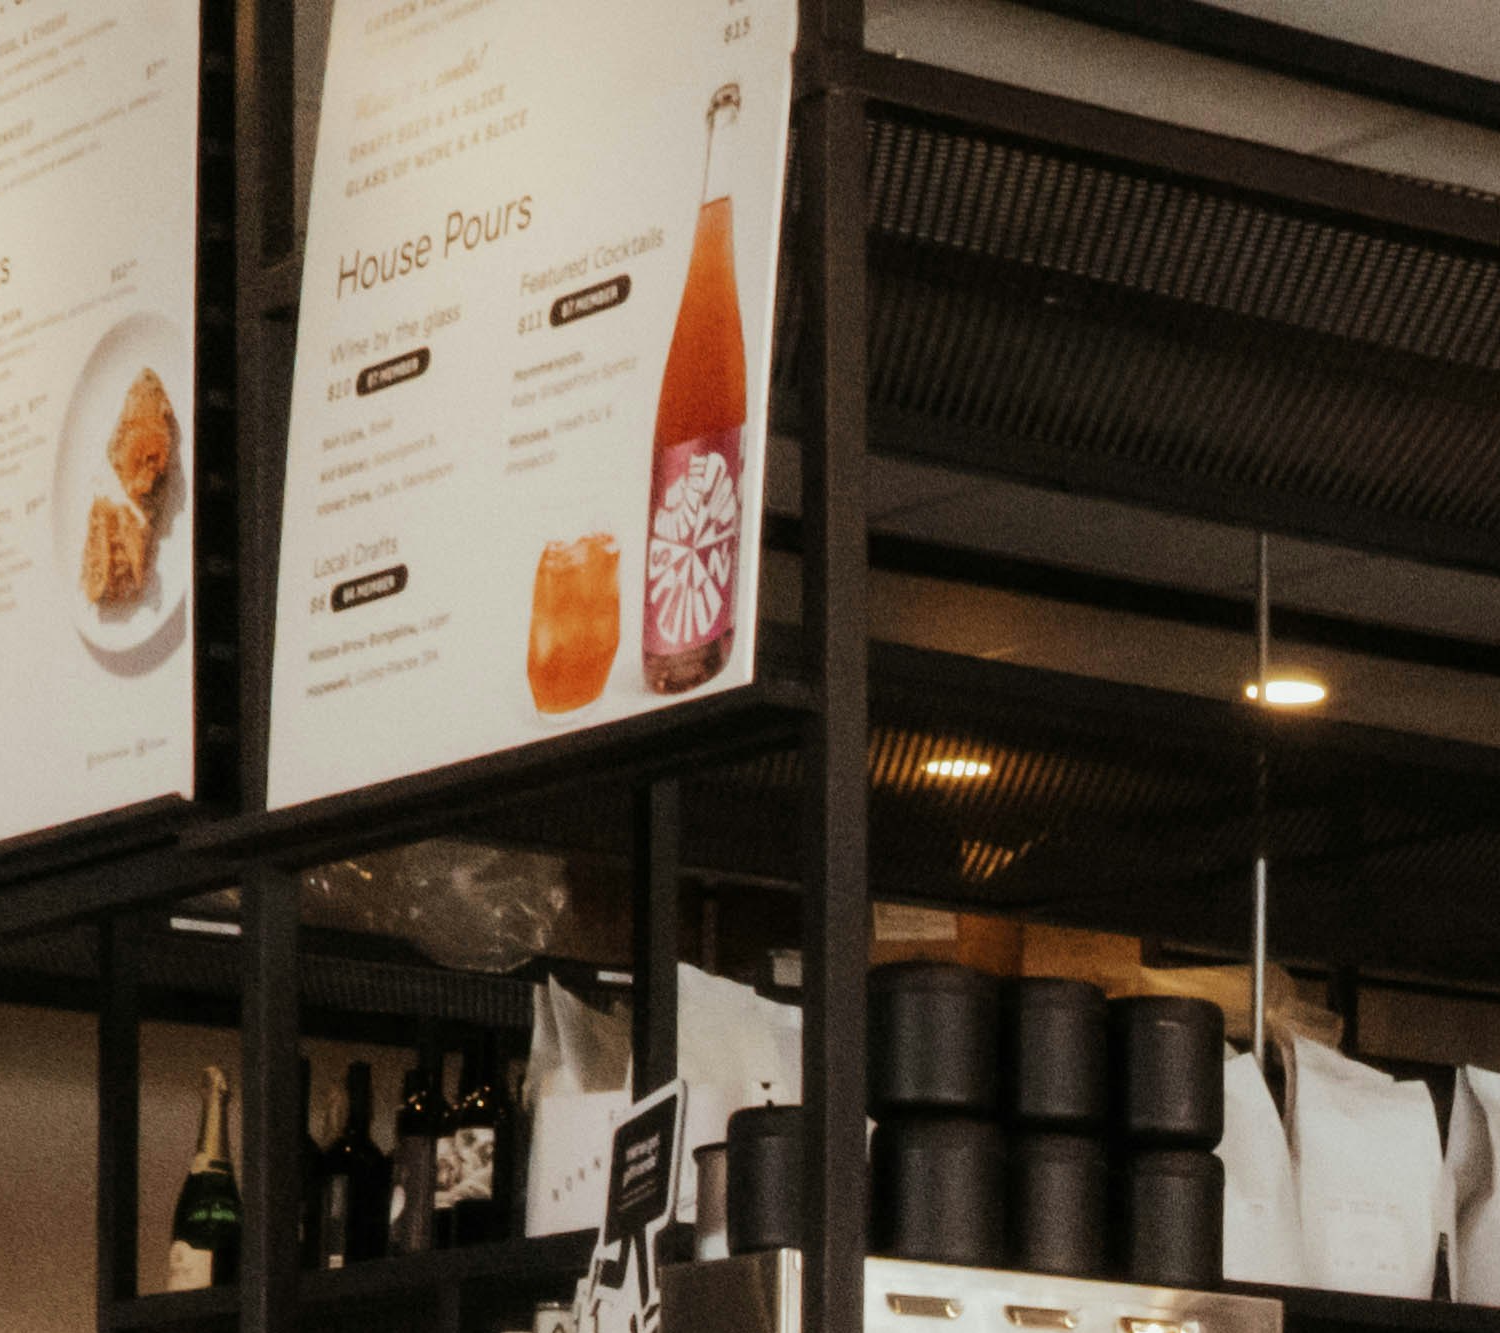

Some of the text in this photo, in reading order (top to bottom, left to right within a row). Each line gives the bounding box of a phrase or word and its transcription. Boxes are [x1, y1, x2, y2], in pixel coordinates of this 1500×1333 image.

[336, 195, 533, 302] House Pours
[519, 226, 665, 297] Featured Cocktails
[330, 303, 462, 364] Wine by the glass
[313, 536, 398, 579] Local Drafts
